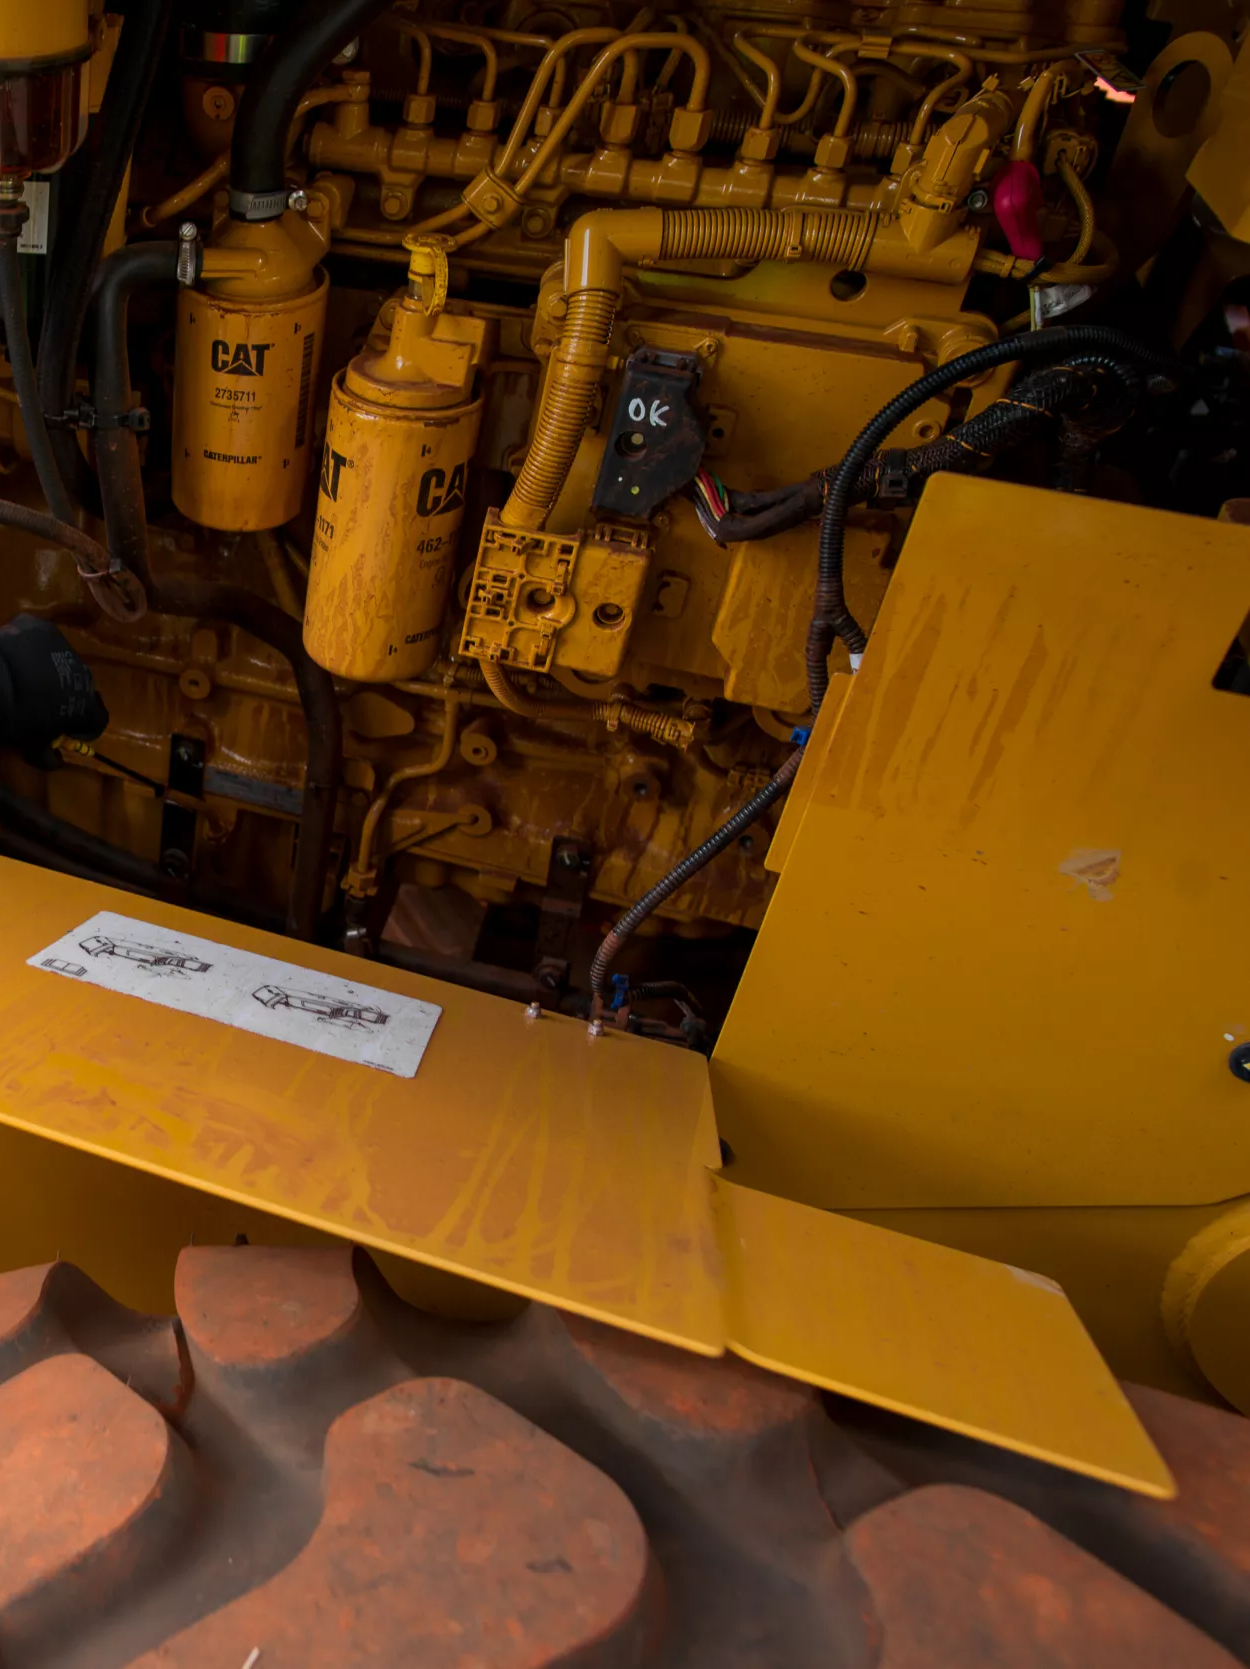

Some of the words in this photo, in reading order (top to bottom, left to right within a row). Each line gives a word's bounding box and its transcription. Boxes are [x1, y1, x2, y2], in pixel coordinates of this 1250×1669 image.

[211, 339, 270, 377] CAT
[214, 387, 256, 402] 2735711
[628, 397, 670, 427] OK
[203, 448, 258, 465] CATERPILLAR
[319, 441, 348, 503] AT
[416, 460, 467, 518] CA
